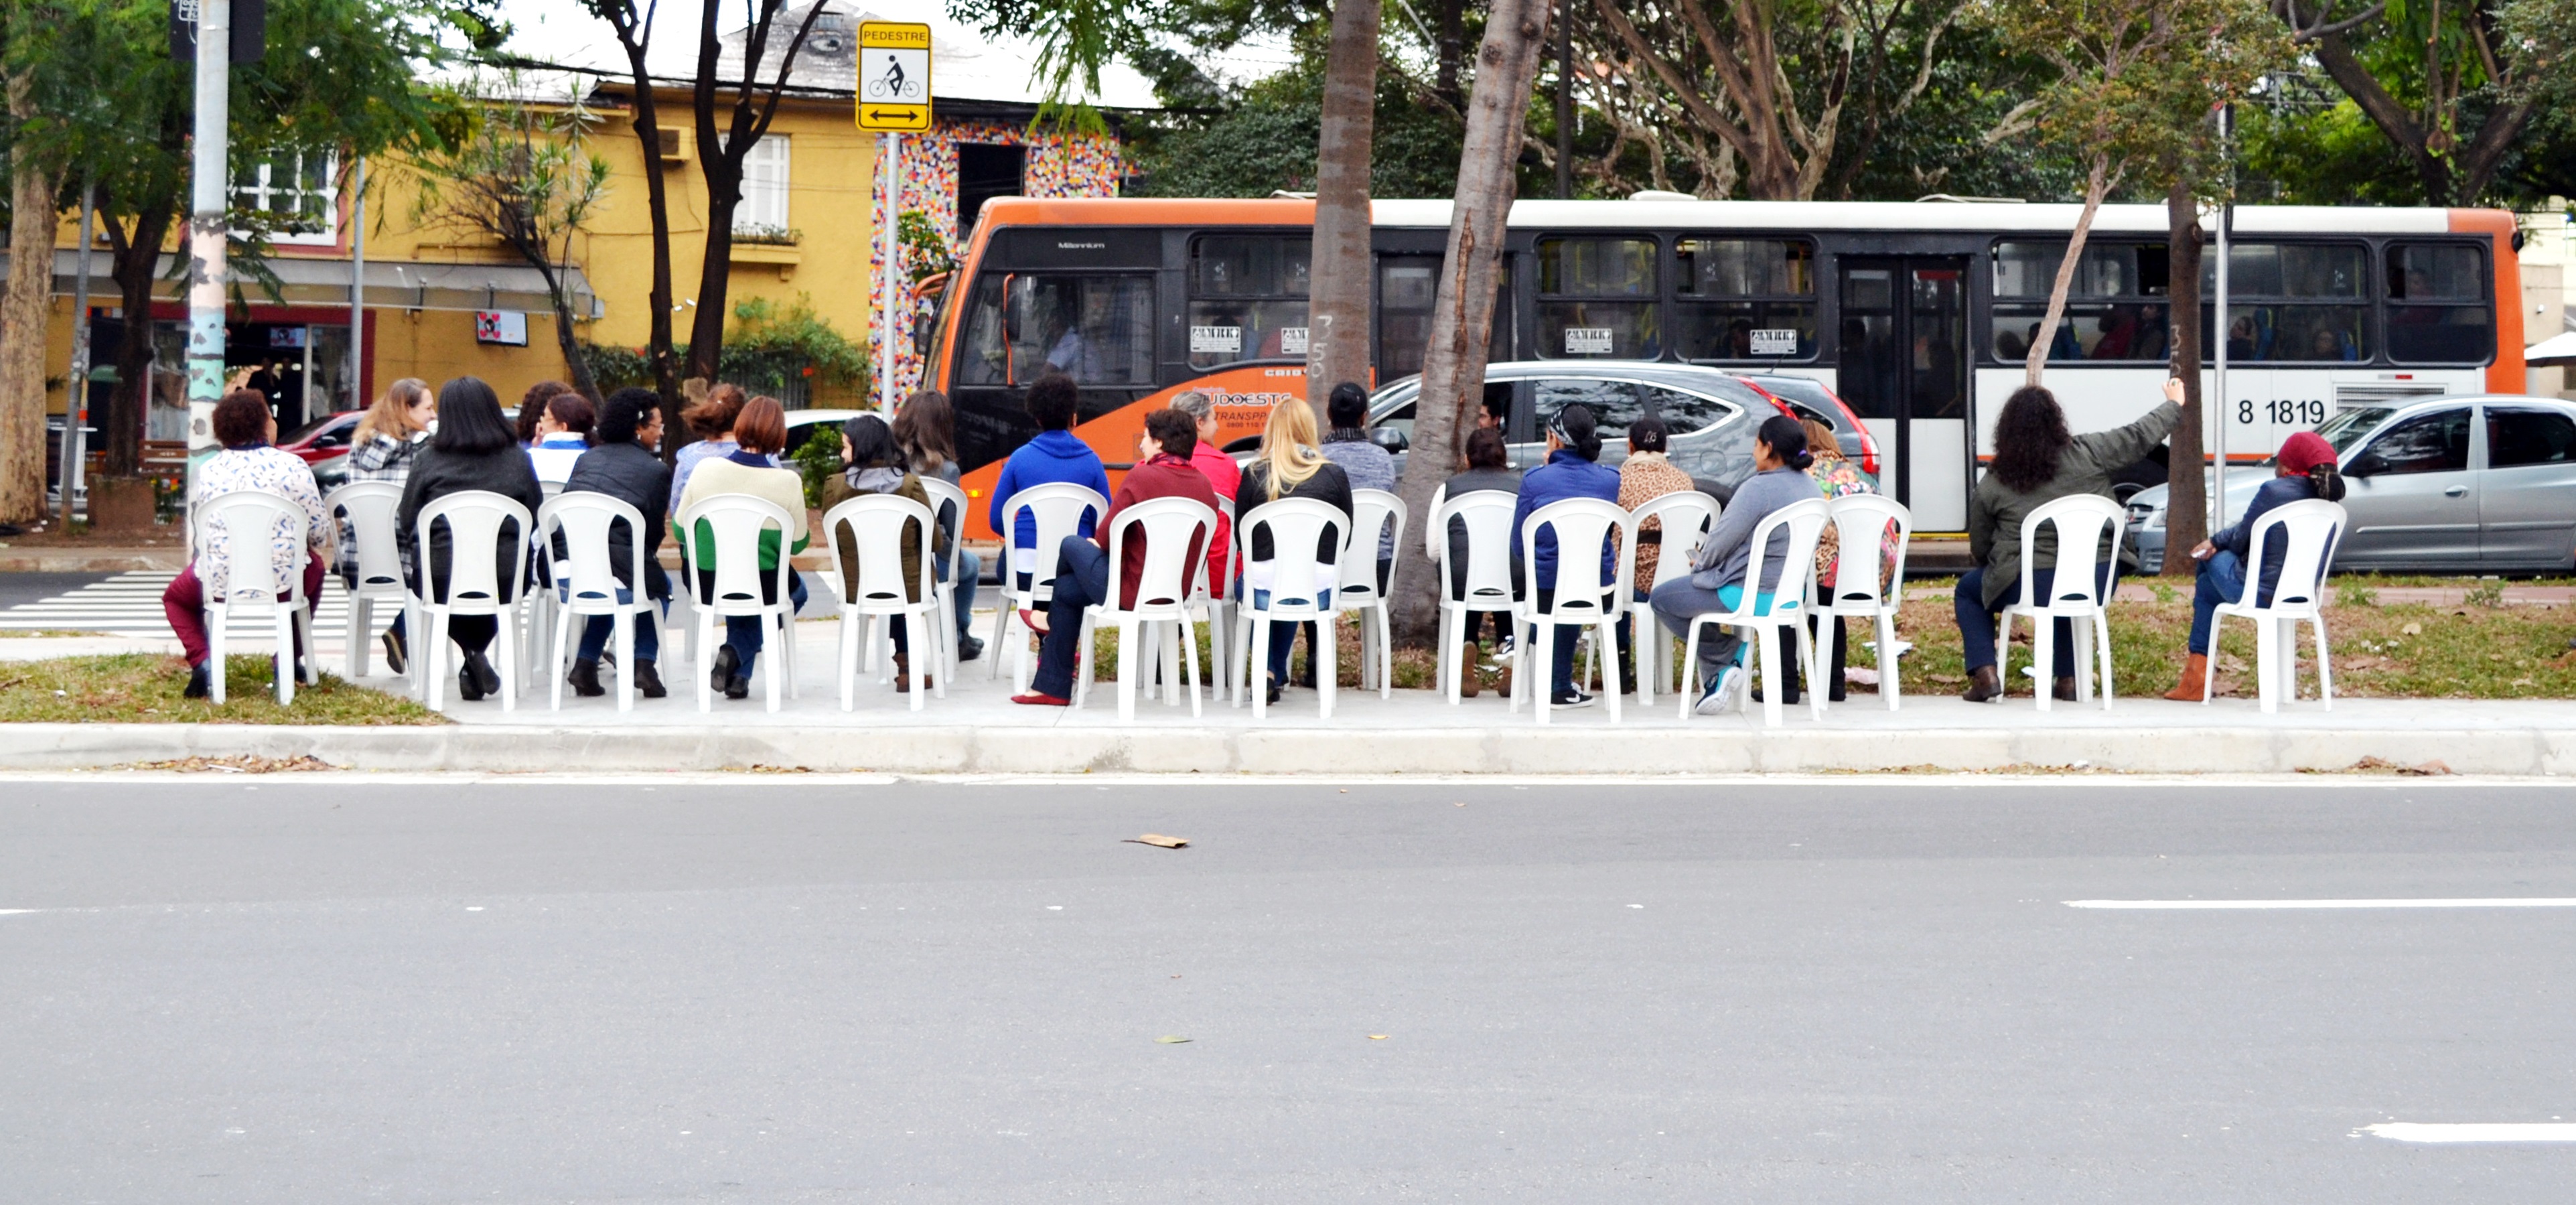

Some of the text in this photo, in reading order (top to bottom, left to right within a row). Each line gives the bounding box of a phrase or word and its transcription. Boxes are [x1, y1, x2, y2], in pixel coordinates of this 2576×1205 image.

[864, 31, 926, 41] PEDESTRE
[2238, 400, 2325, 424] 8 1819
